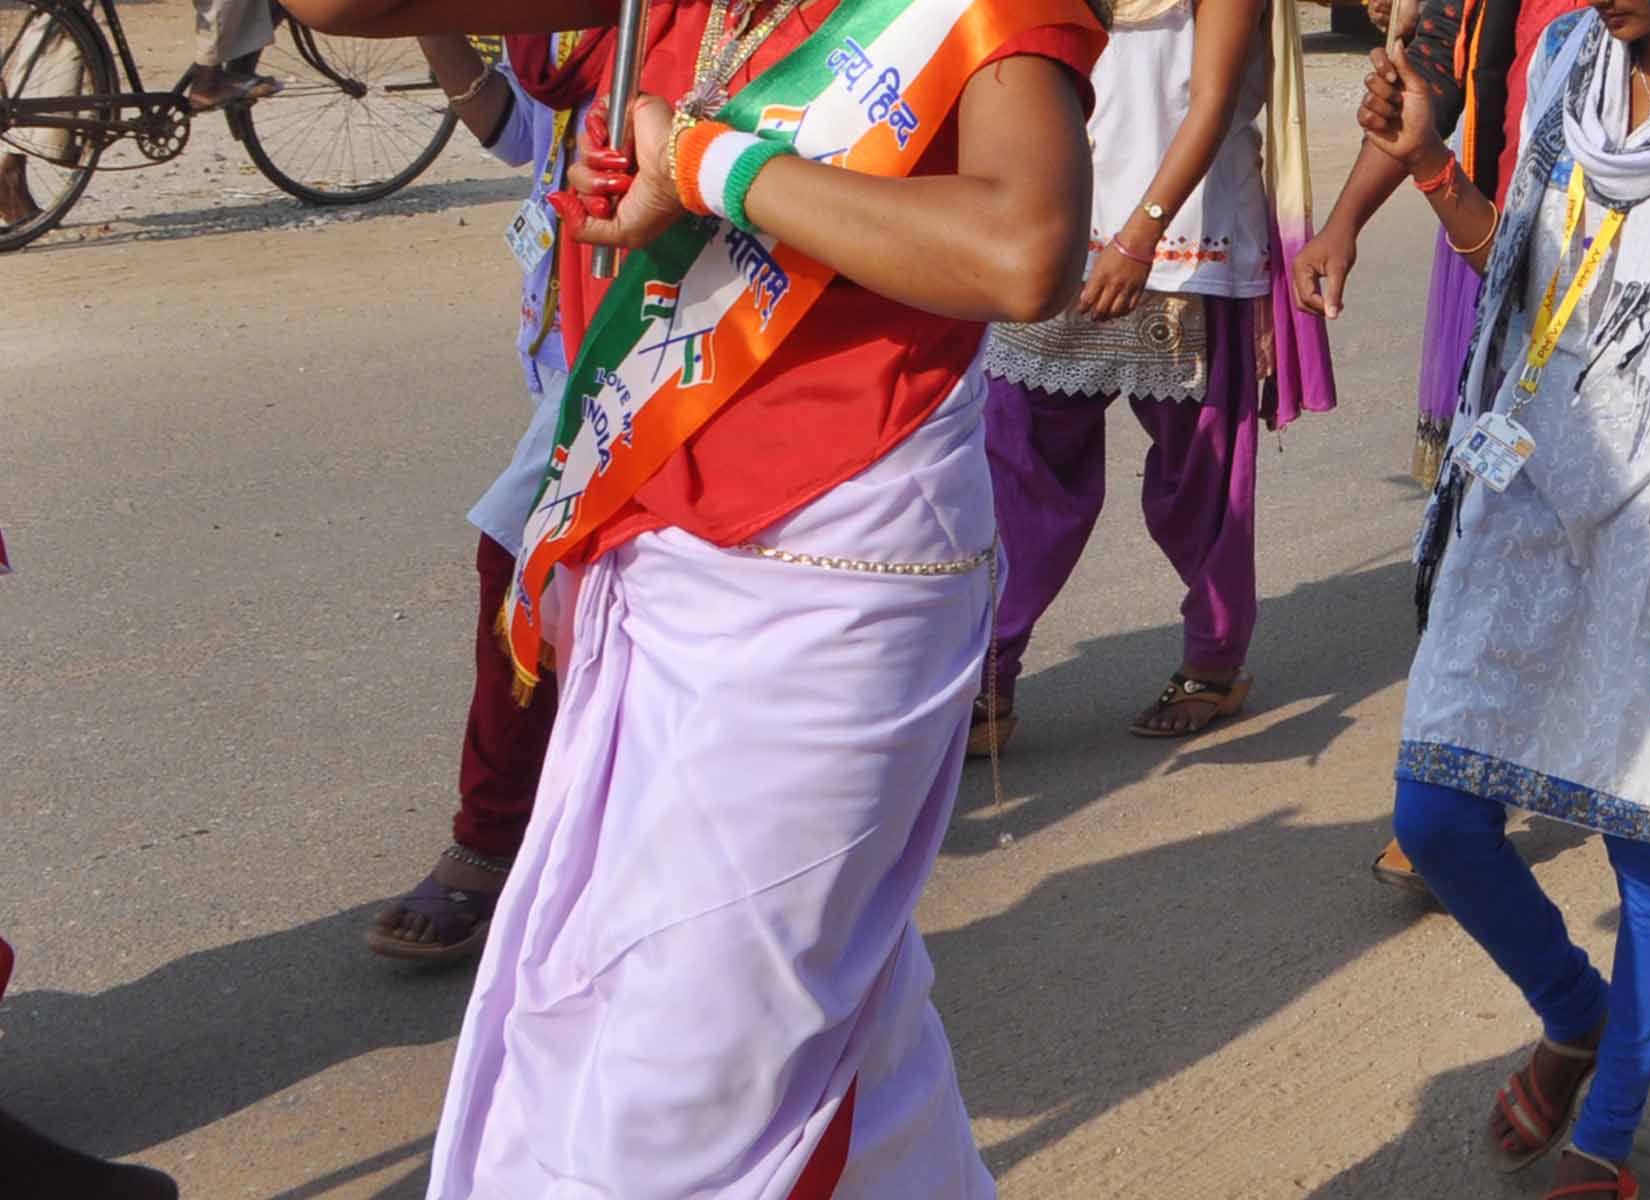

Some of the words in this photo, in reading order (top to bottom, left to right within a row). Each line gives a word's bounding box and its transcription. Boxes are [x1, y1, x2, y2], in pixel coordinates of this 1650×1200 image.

[826, 37, 874, 92] जय
[858, 67, 920, 149] हिन्द
[582, 394, 613, 477] INDIA
[621, 411, 633, 449] MY
